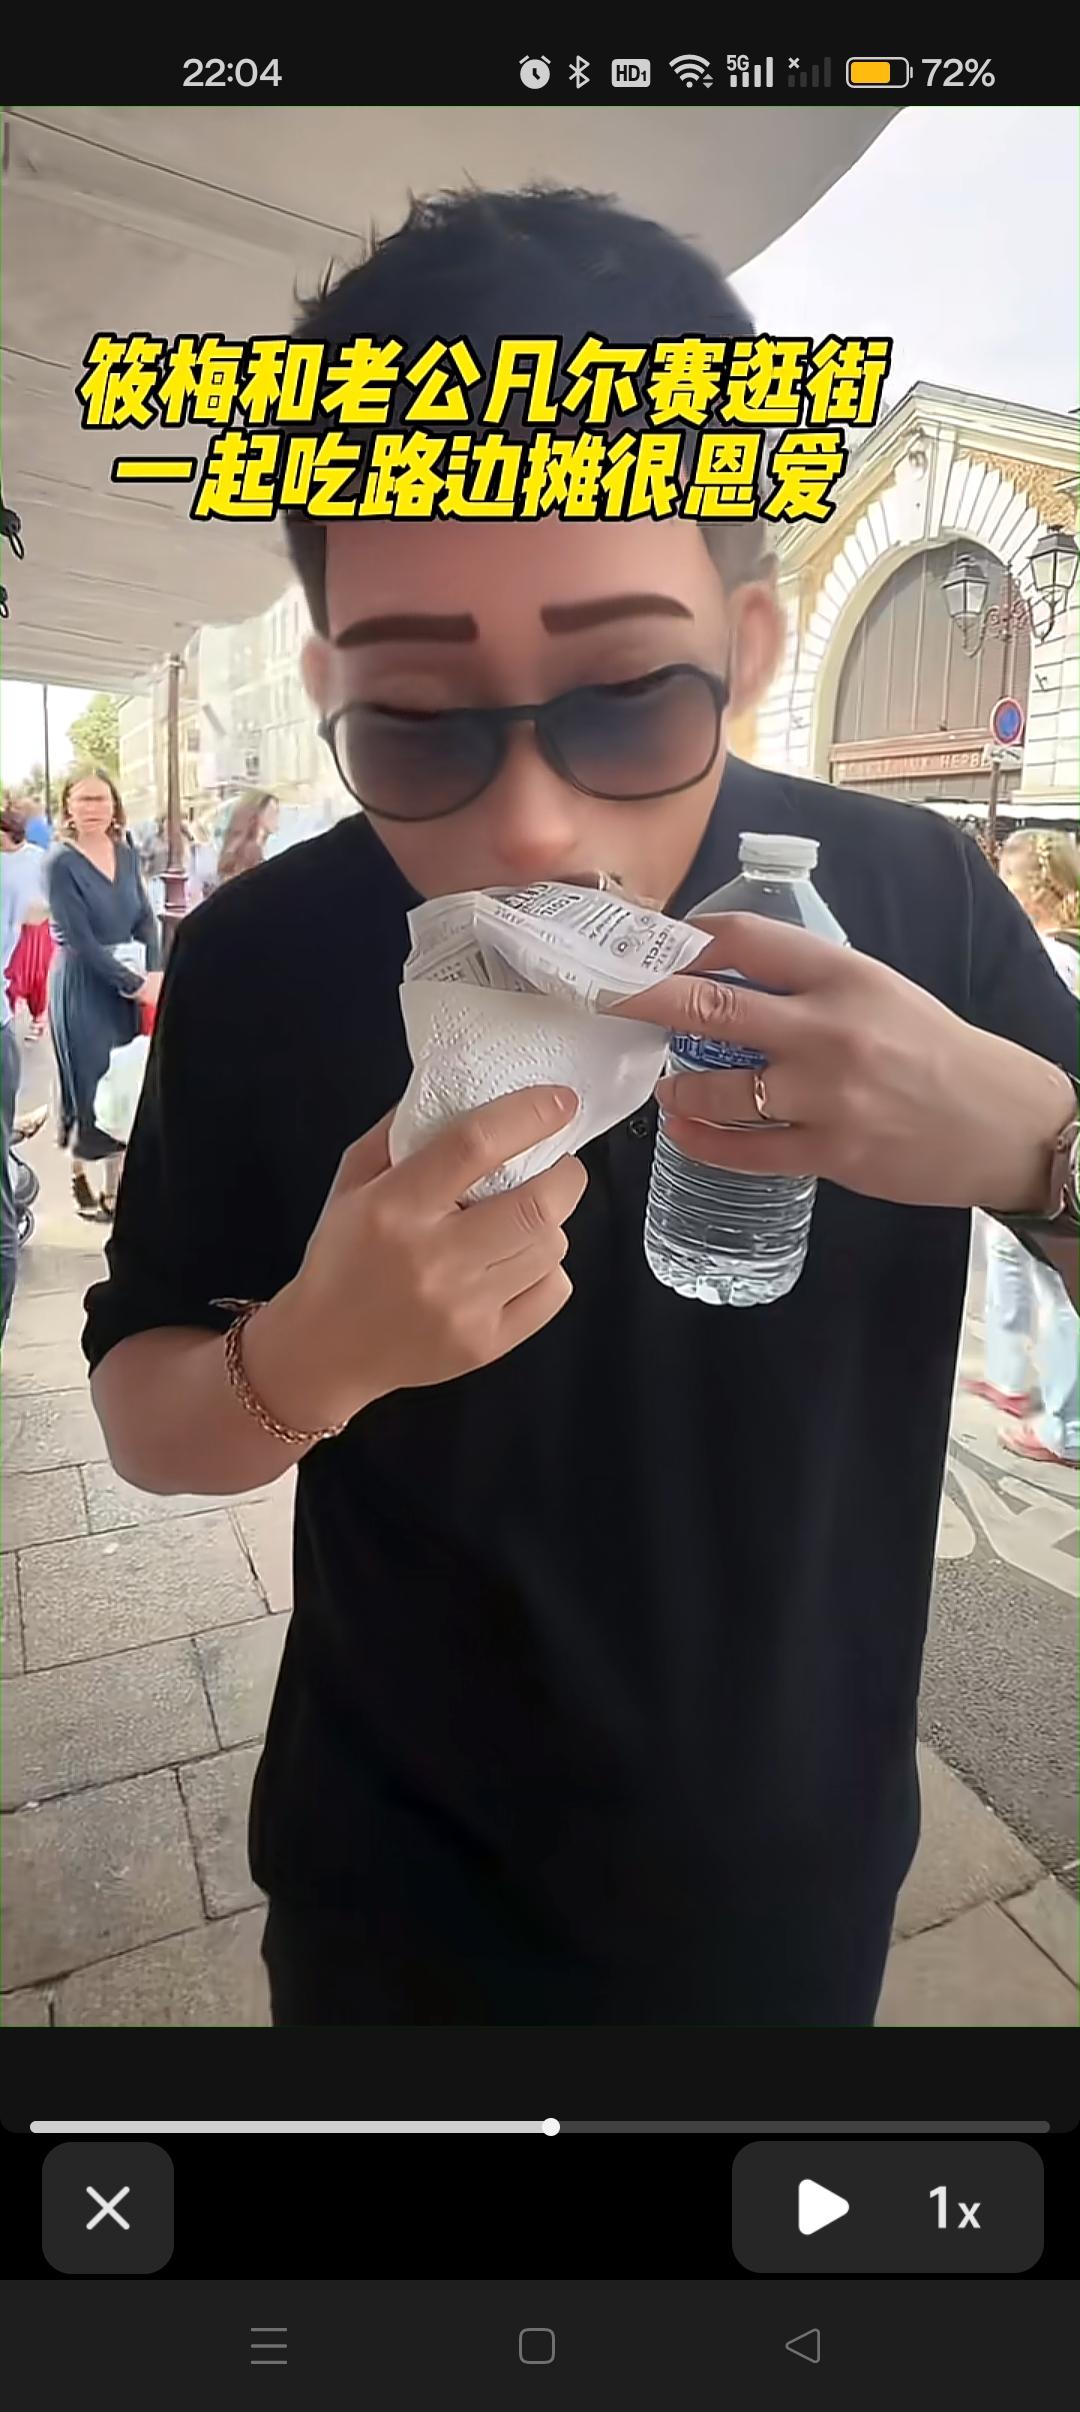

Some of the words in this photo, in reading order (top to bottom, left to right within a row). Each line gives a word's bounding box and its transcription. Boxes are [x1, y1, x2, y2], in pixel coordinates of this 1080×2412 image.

[182, 58, 283, 87] 22:04
[726, 54, 749, 72] 5G
[921, 58, 996, 88] 72%
[929, 2185, 981, 2229] 1x
